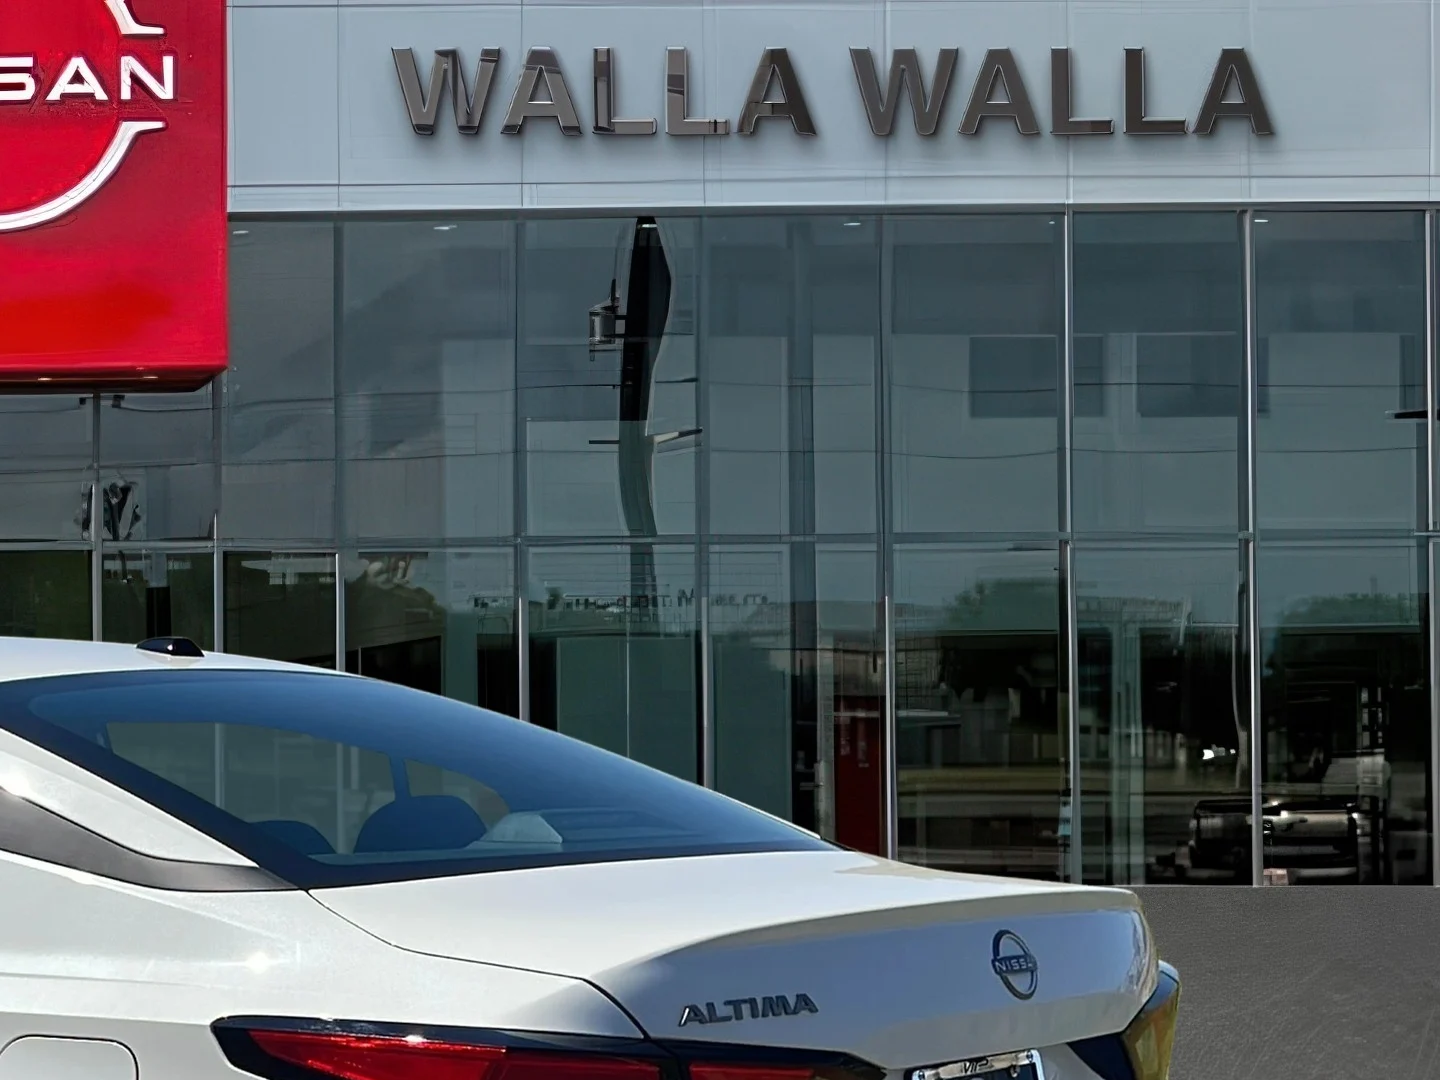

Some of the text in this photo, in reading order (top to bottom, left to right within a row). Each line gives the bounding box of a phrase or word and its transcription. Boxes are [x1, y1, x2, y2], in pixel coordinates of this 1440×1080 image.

[391, 46, 1274, 136] WALLA WALLA
[994, 958, 1035, 972] NISS
[678, 993, 819, 1027] ALTIMA
